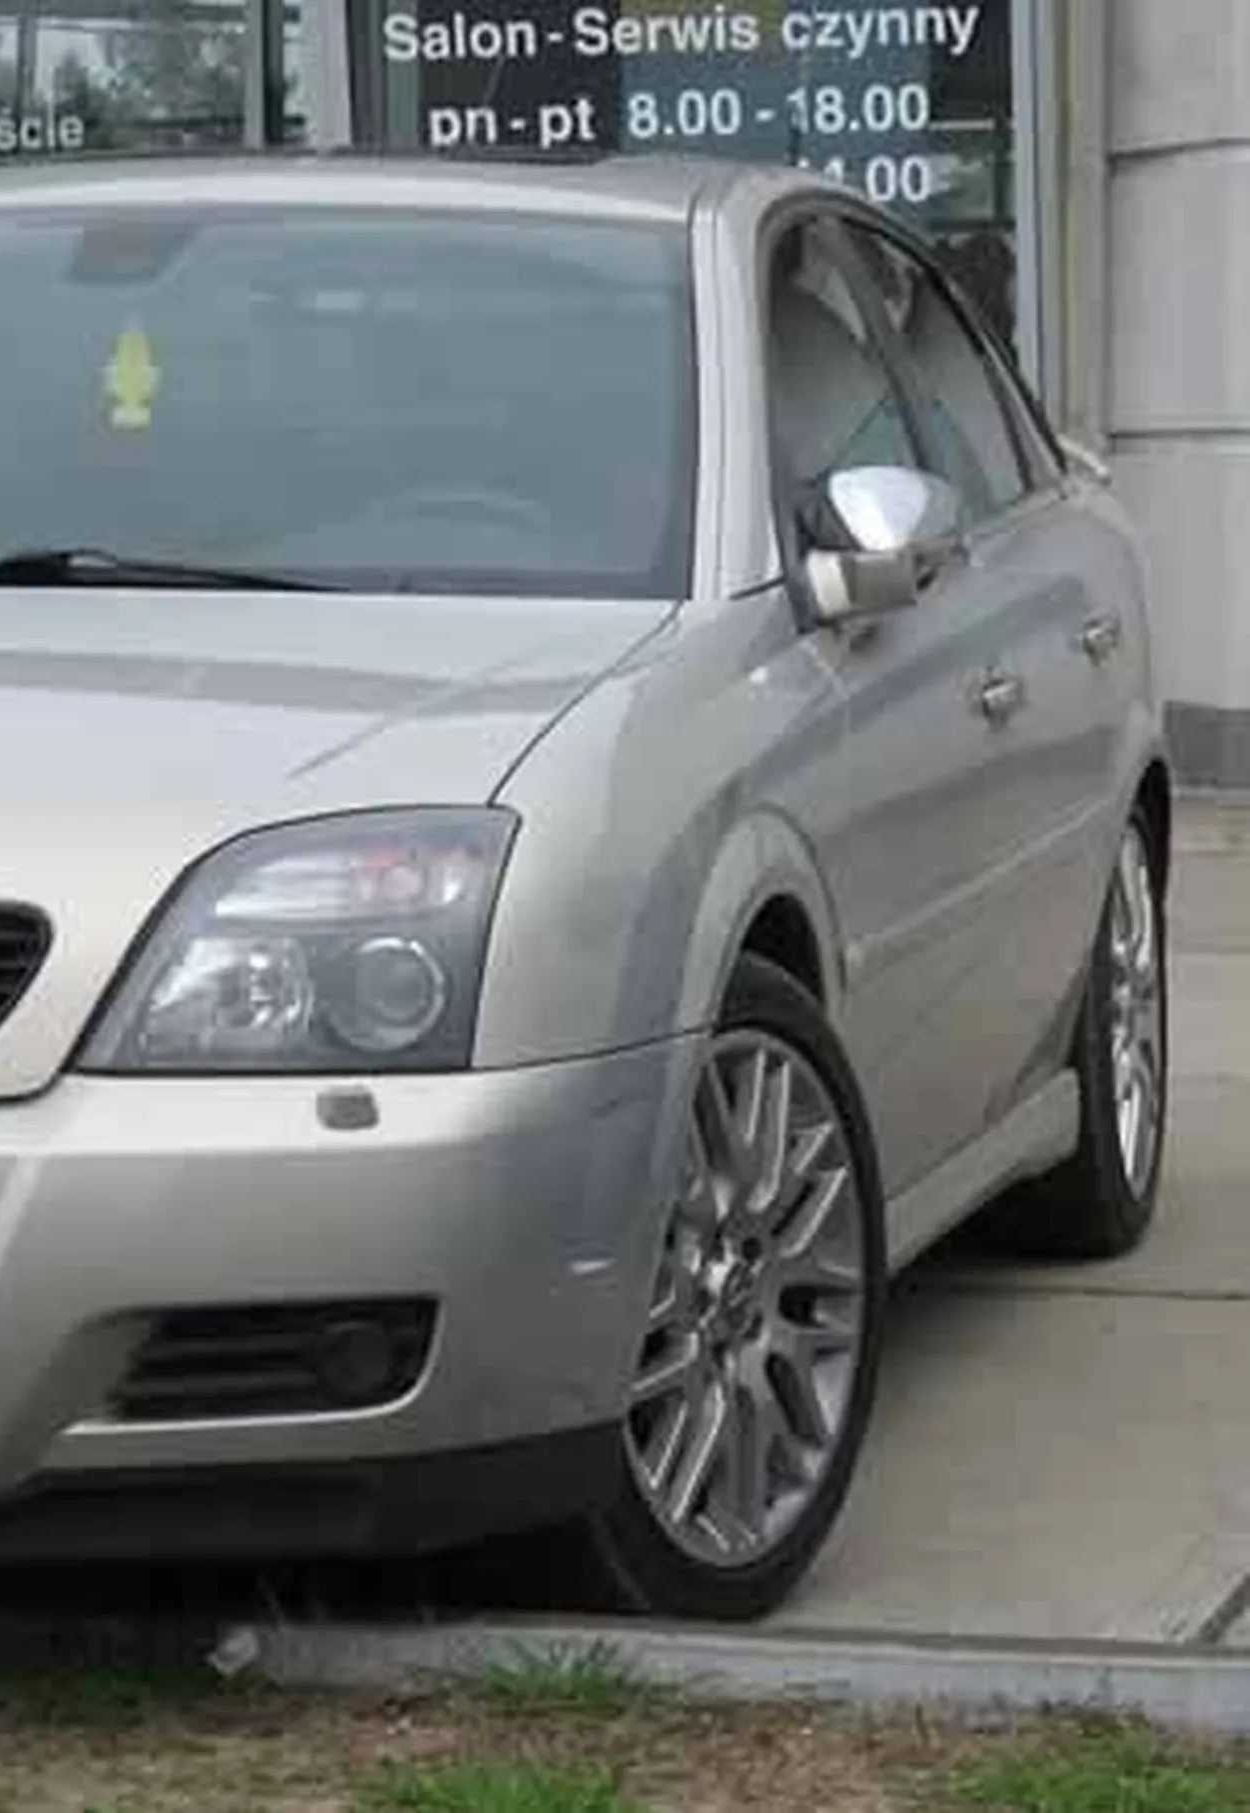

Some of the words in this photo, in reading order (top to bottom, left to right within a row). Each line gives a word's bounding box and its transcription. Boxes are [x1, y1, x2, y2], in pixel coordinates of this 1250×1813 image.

[383, 11, 537, 61] Salon
[573, 6, 760, 55] Serwis
[782, 6, 979, 59] czynny
[429, 107, 497, 148] pn
[539, 98, 595, 150] pt
[627, 91, 741, 138] 8.00
[786, 83, 930, 134] 18.00
